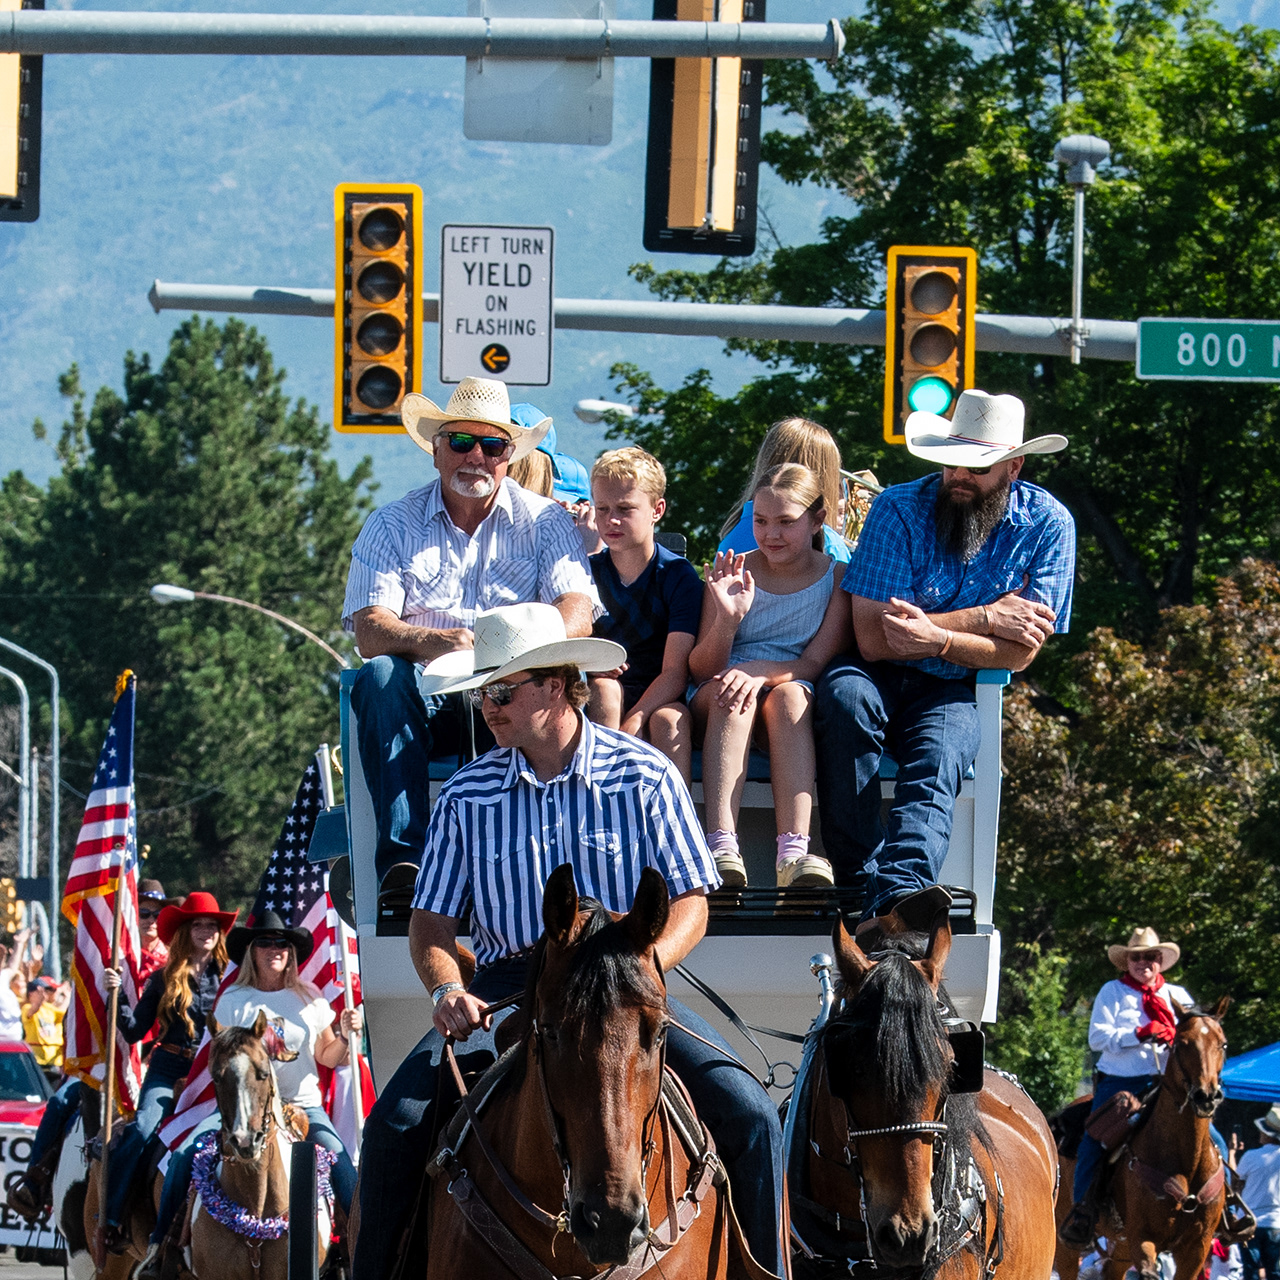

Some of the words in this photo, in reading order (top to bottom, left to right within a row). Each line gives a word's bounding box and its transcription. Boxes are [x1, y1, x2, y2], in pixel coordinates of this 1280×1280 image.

[450, 236, 490, 253] LEFT
[501, 237, 544, 254] TURN
[463, 262, 532, 287] YIELD
[485, 294, 507, 312] ON
[456, 318, 536, 336] FLASHING
[1177, 333, 1246, 367] 800
